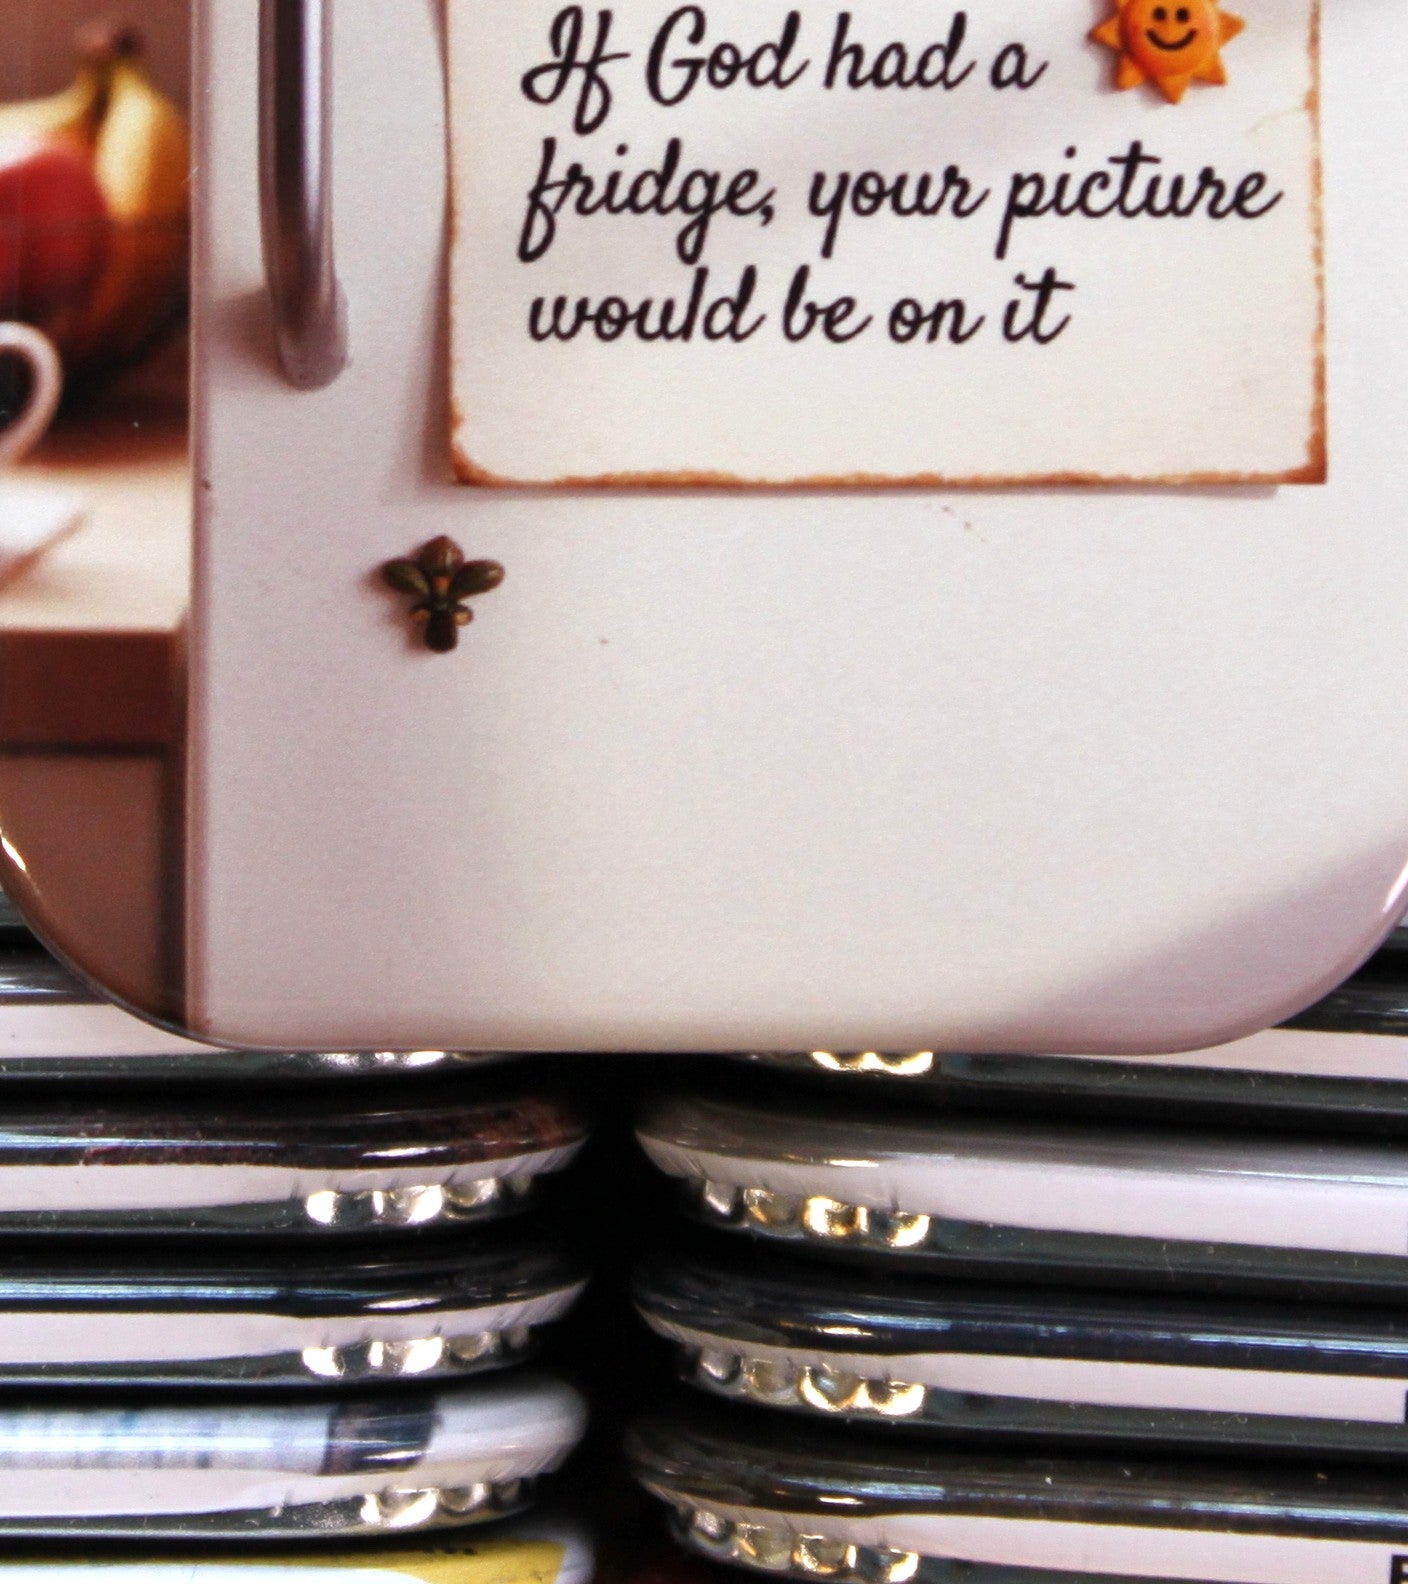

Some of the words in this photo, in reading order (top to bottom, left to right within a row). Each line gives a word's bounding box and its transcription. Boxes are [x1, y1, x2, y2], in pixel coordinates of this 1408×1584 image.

[521, 4, 628, 134] If
[647, 6, 810, 106] God
[824, 11, 974, 90] had
[990, 37, 1047, 90] a
[518, 137, 776, 264] fridge,
[807, 165, 990, 260] your
[995, 140, 1284, 261] picture
[529, 265, 766, 344] would
[784, 265, 872, 344] be
[889, 293, 983, 344] on
[1001, 267, 1076, 345] it
